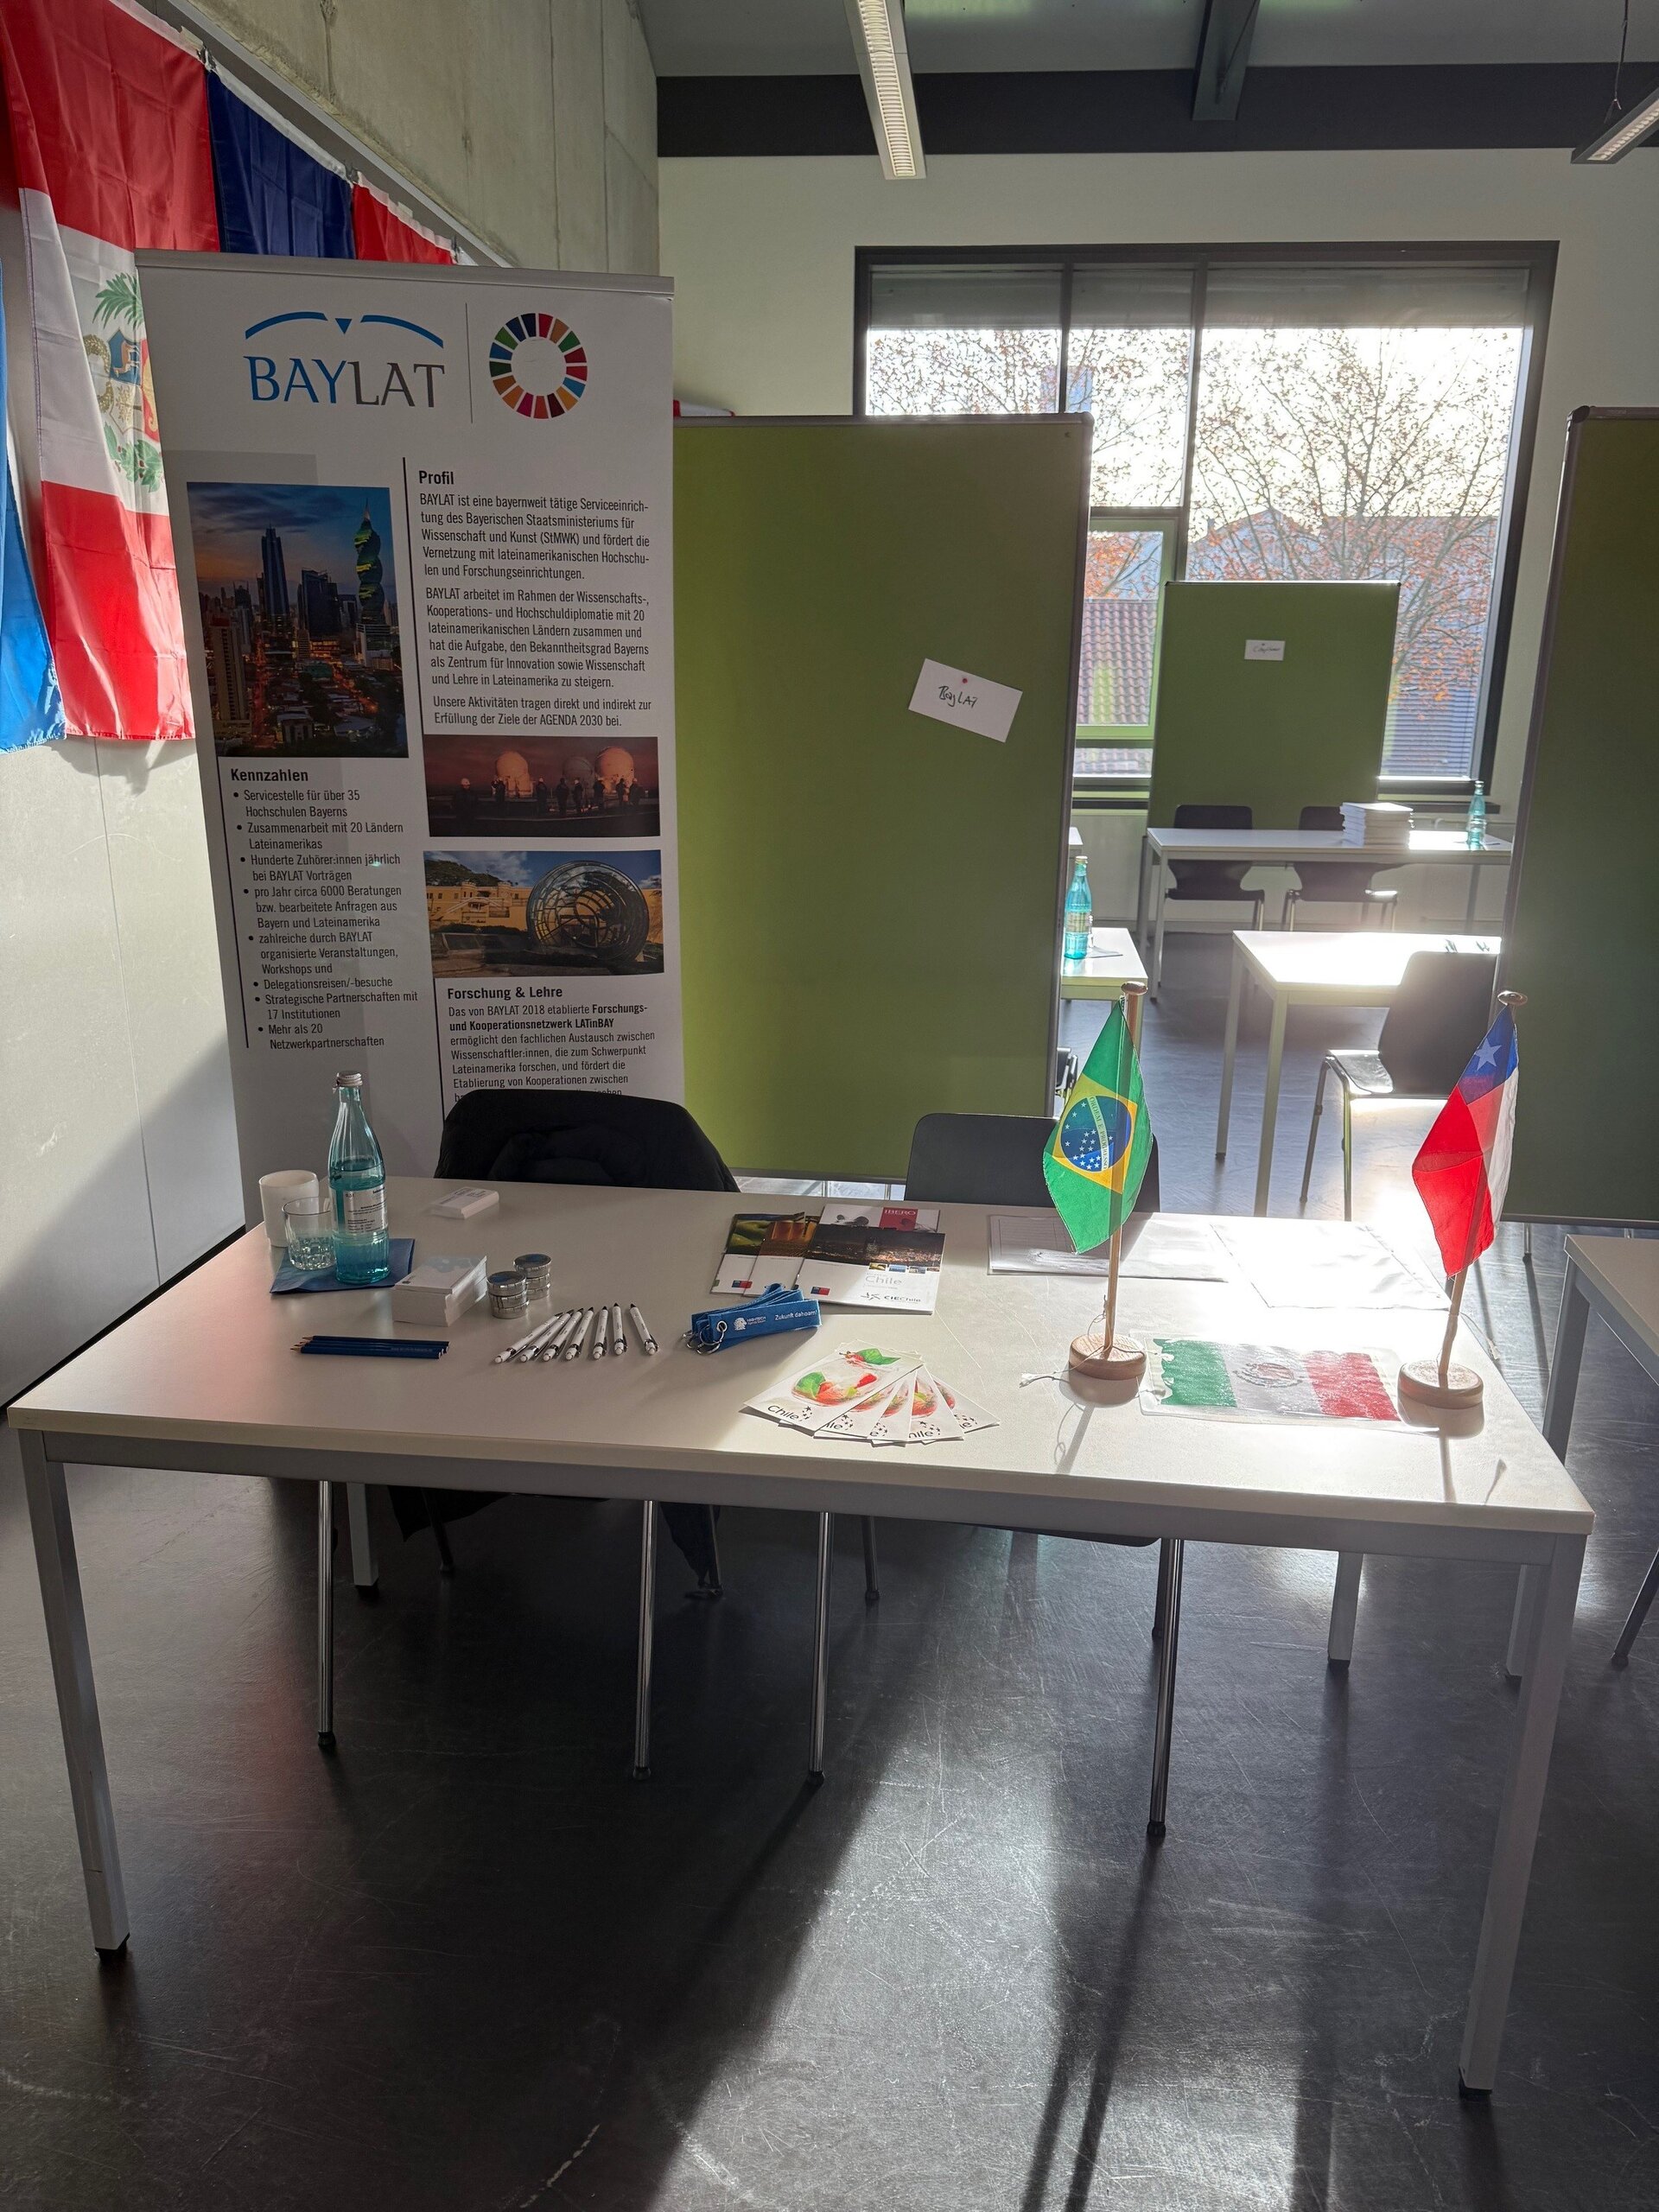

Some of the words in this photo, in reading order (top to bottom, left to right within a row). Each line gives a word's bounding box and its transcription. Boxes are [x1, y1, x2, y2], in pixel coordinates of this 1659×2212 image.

[244, 355, 445, 408] BAYLAT
[418, 470, 454, 484] Profil
[419, 493, 454, 505] BAYLAT
[457, 494, 470, 505] ist
[472, 494, 493, 506] eine
[495, 495, 547, 511] bayernweit
[550, 497, 577, 512] tätige
[580, 498, 648, 512] Serviceeinrich-
[421, 511, 443, 525] tung
[446, 512, 463, 524] des
[466, 512, 523, 527] Bayerischen
[525, 513, 619, 528] Staatsministeriums
[620, 517, 634, 528] für
[421, 528, 486, 542] Wissenschaft
[489, 531, 506, 542] und
[510, 531, 537, 543] Kunst
[540, 531, 579, 545] (StMWK)
[582, 533, 600, 544] und
[602, 533, 633, 546] fördert
[635, 535, 649, 546] die
[423, 546, 476, 561] Vernetzung
[479, 548, 494, 559] mit
[498, 548, 598, 562] lateinamerikanischen
[601, 550, 649, 563] Hochschu-
[425, 587, 460, 599] BAYLAT
[463, 588, 499, 601] arbeitet
[503, 589, 514, 601] im
[518, 588, 556, 601] Rahmen
[559, 590, 574, 601] der
[576, 591, 648, 605] Wissenschafts-,
[426, 604, 492, 619] Kooperations-
[495, 607, 512, 617] und
[516, 607, 613, 621] Hochschuldiplomatie
[615, 609, 631, 620] mit
[633, 609, 645, 620] 20
[428, 621, 529, 635] lateinamerikanischen
[532, 624, 569, 636] Ländern
[573, 627, 622, 637] zusammen
[625, 626, 641, 638] und
[429, 639, 445, 650] hat
[448, 639, 462, 651] die
[465, 639, 506, 653] Aufgabe,
[510, 640, 526, 652] den
[529, 640, 611, 656] Bekanntheitsgrad
[613, 642, 649, 657] Bayerns
[430, 656, 445, 667] als
[448, 656, 486, 668] Zentrum
[490, 657, 504, 668] für
[506, 658, 555, 669] Innovation
[557, 658, 583, 670] sowie
[585, 658, 645, 671] Wissenschaft
[431, 673, 449, 683] und
[452, 673, 478, 684] Lehre
[480, 674, 489, 684] in
[493, 674, 558, 686] Lateinamerika
[561, 677, 571, 686] zu
[574, 676, 613, 690] steigern.
[433, 696, 466, 707] Unsere
[467, 696, 518, 708] Aktivitäten
[520, 697, 550, 710] tragen
[553, 697, 580, 709] direkt
[582, 698, 600, 709] und
[602, 697, 636, 709] indirekt
[434, 712, 478, 726] Erfüllung
[480, 713, 495, 724] der
[498, 713, 520, 724] Ziele
[522, 714, 537, 724] der
[539, 714, 577, 725] AGENDA
[579, 715, 602, 726] 2030
[605, 715, 621, 726] bei.
[231, 768, 308, 781] Kennzahlen
[244, 789, 304, 802] Servicestelle
[306, 789, 321, 800] für
[323, 789, 345, 800] über
[347, 789, 359, 800] 35
[245, 805, 306, 817] Hochschulen
[308, 805, 347, 818] Bayerns
[247, 822, 328, 835] Zusammenarbeit
[331, 822, 347, 832] mit
[350, 822, 363, 832] 20
[365, 822, 403, 832] Ländern
[249, 838, 322, 849] Lateinamerikas
[251, 854, 294, 865] Hunderte
[296, 854, 362, 865] Zuhörer:innen
[365, 853, 400, 867] jährlich
[254, 888, 269, 899] pro
[271, 887, 291, 896] Jahr
[294, 886, 317, 896] circa
[320, 885, 345, 896] 6000
[346, 885, 401, 897] Beratungen
[255, 902, 276, 912] bzw.
[278, 901, 333, 912] bearbeitete
[334, 900, 378, 913] Anfragen
[380, 902, 397, 911] aus
[257, 917, 289, 930] Bayern
[292, 918, 310, 927] und
[313, 916, 379, 927] Lateinamerika
[258, 932, 307, 944] zahlreiche
[309, 932, 336, 944] durch
[339, 930, 372, 942] BAYLAT
[260, 948, 316, 961] organisierte
[318, 946, 397, 959] Veranstaltungen,
[264, 976, 392, 991] Delegationsreisen/-besuche
[264, 993, 324, 1006] Strategische
[326, 991, 400, 1002] Partnerschaften
[403, 990, 417, 1001] mit
[447, 987, 511, 1001] Forschung
[515, 986, 525, 997] &
[529, 986, 563, 997] Lehre
[448, 1007, 466, 1016] Das
[486, 1005, 519, 1015] BAYLAT
[522, 1004, 544, 1014] 2018
[546, 1004, 589, 1014] etablierte
[592, 1003, 647, 1014] Forschungs-
[449, 1021, 467, 1031] und
[469, 1019, 572, 1032] Kooperationsnetzwerk
[575, 1018, 613, 1027] LATinBAY
[270, 1035, 384, 1051] Netzwerkpartnerschaften
[450, 1034, 498, 1047] ermöglicht
[500, 1034, 517, 1044] den
[519, 1033, 566, 1043] fachlichen
[569, 1032, 613, 1042] Austausch
[616, 1031, 654, 1041] zwischen
[450, 1047, 551, 1059] Wissenschaftler:innen,
[555, 1046, 569, 1057] die
[591, 1045, 645, 1058] Schwerpunkt
[452, 1063, 516, 1074] Lateinamerika
[518, 1061, 558, 1072] forschen,
[562, 1061, 578, 1071] und
[581, 1060, 609, 1070] fördert
[612, 1059, 625, 1069] die
[453, 1077, 505, 1090] Etablierung
[525, 1075, 587, 1086] Kooperationen
[589, 1073, 628, 1084] zwischen
[1089, 1096, 1102, 1122] ORDEM
[866, 1274, 902, 1285] Chile
[767, 1405, 799, 1421] Chile
